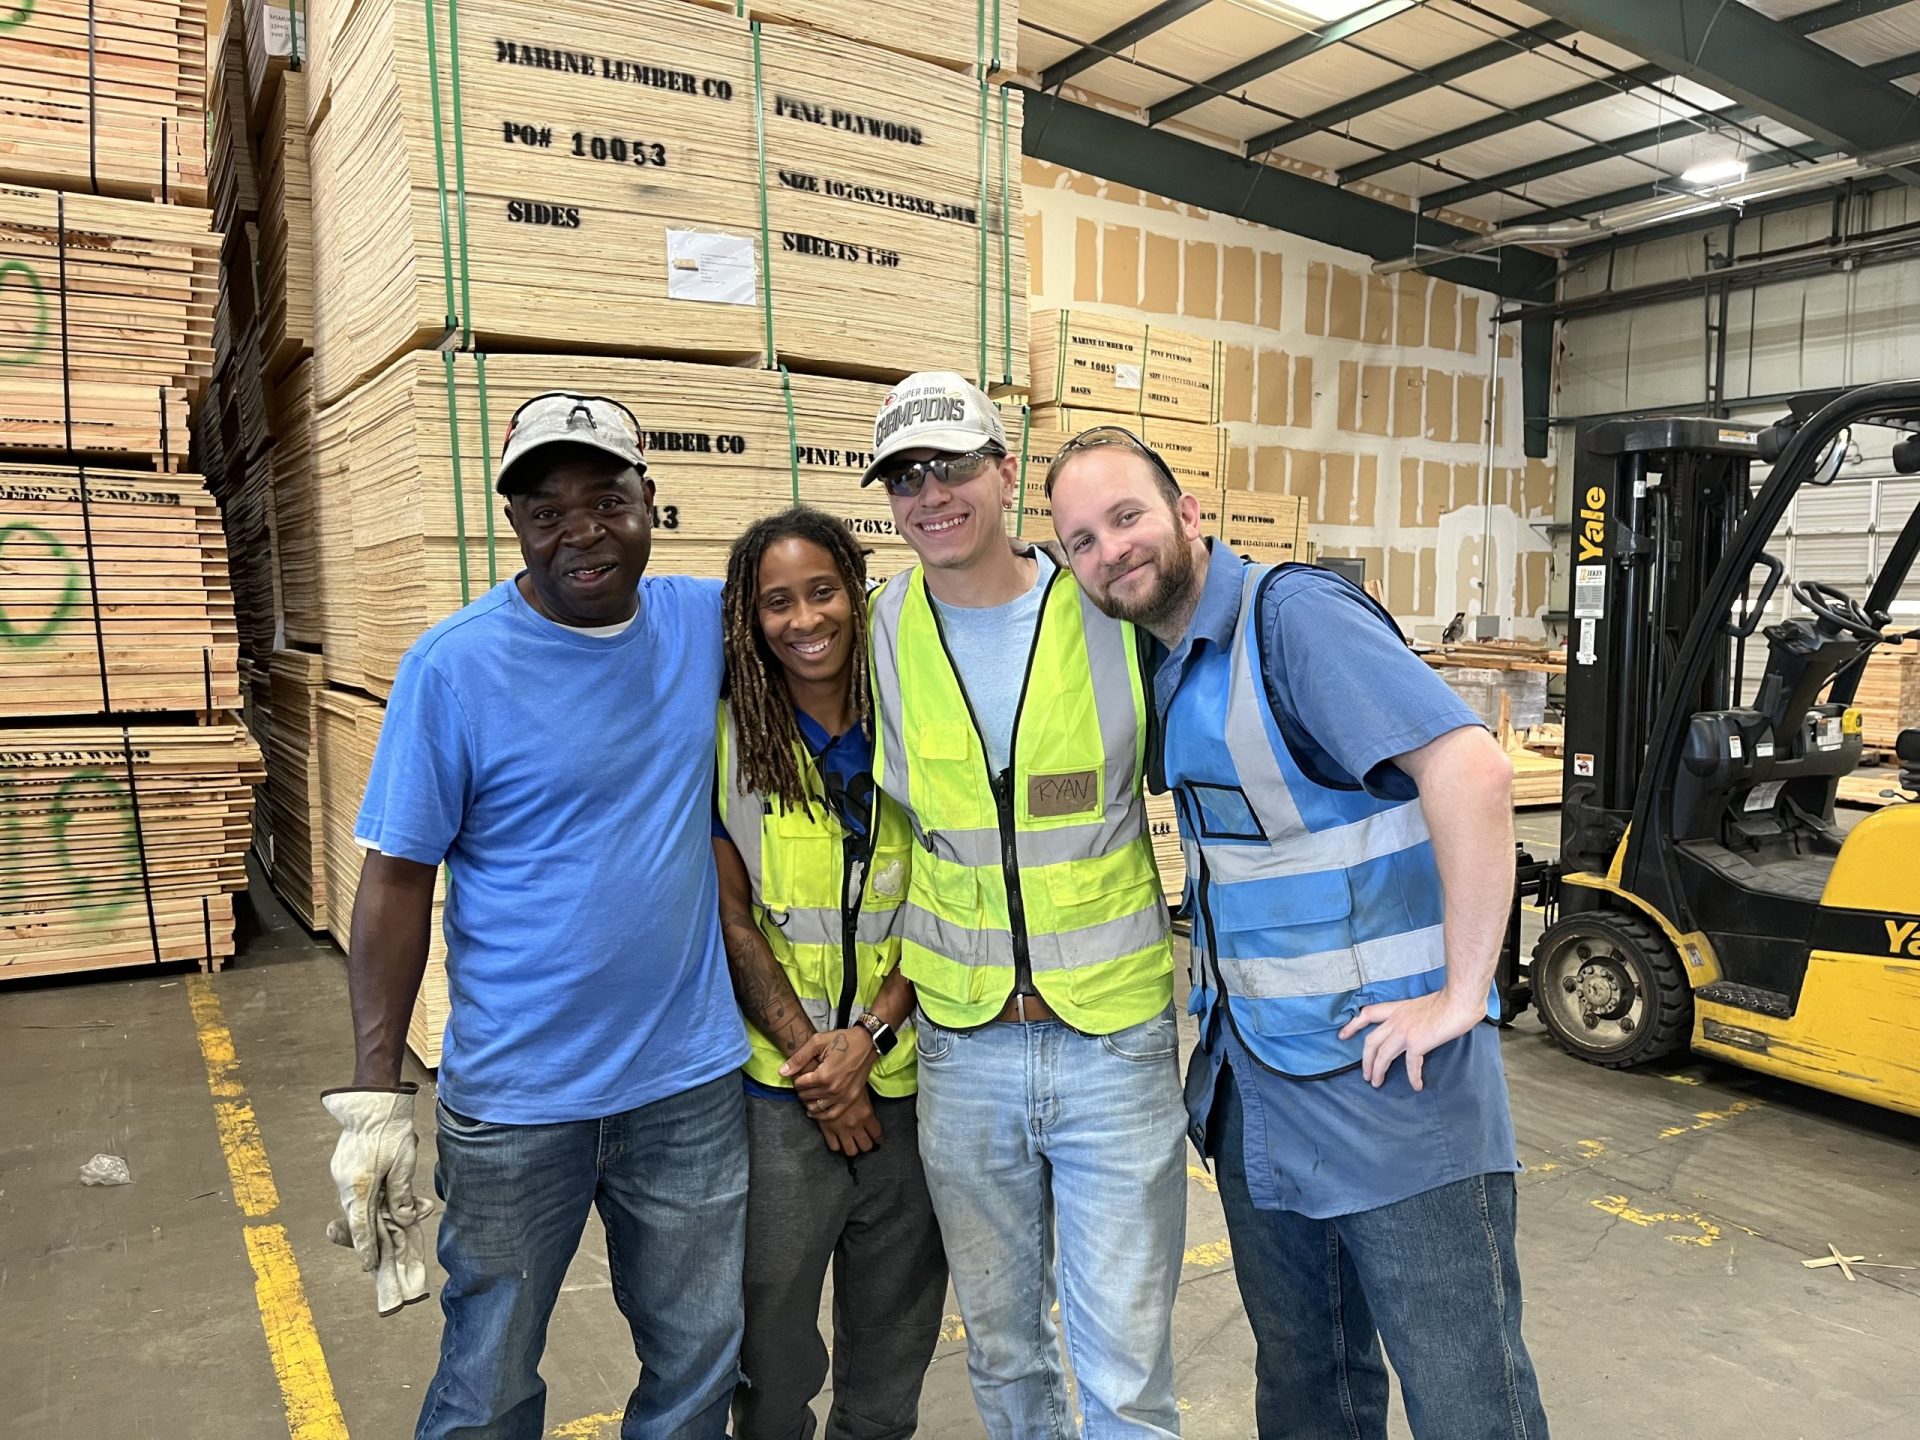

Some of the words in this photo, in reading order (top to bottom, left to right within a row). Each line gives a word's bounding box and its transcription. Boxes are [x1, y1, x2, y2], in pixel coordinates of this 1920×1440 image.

[495, 39, 595, 76] MARINE
[602, 57, 697, 95] LUMBER
[702, 78, 732, 101] CO
[775, 95, 827, 126] PINE
[831, 110, 923, 146] PLYWOOD
[503, 121, 552, 148] PO#
[572, 132, 666, 167] 10053
[779, 170, 819, 193] SIZE
[507, 200, 580, 228] SIDES
[783, 232, 859, 262] SHEETS
[1072, 336, 1097, 346] MARINE
[1098, 340, 1123, 350] LUMBER
[1091, 361, 1115, 374] 10053
[899, 388, 921, 401] SUPER
[923, 387, 946, 395] BOWL
[875, 397, 965, 448] CHAMPIONS
[717, 435, 745, 454] CO
[796, 446, 840, 466] PINE
[1207, 512, 1217, 521] CO
[1231, 514, 1246, 522] PINE
[1247, 515, 1275, 524] PLYWOOD
[1579, 486, 1606, 562] Yale
[1034, 775, 1090, 802] RYAN
